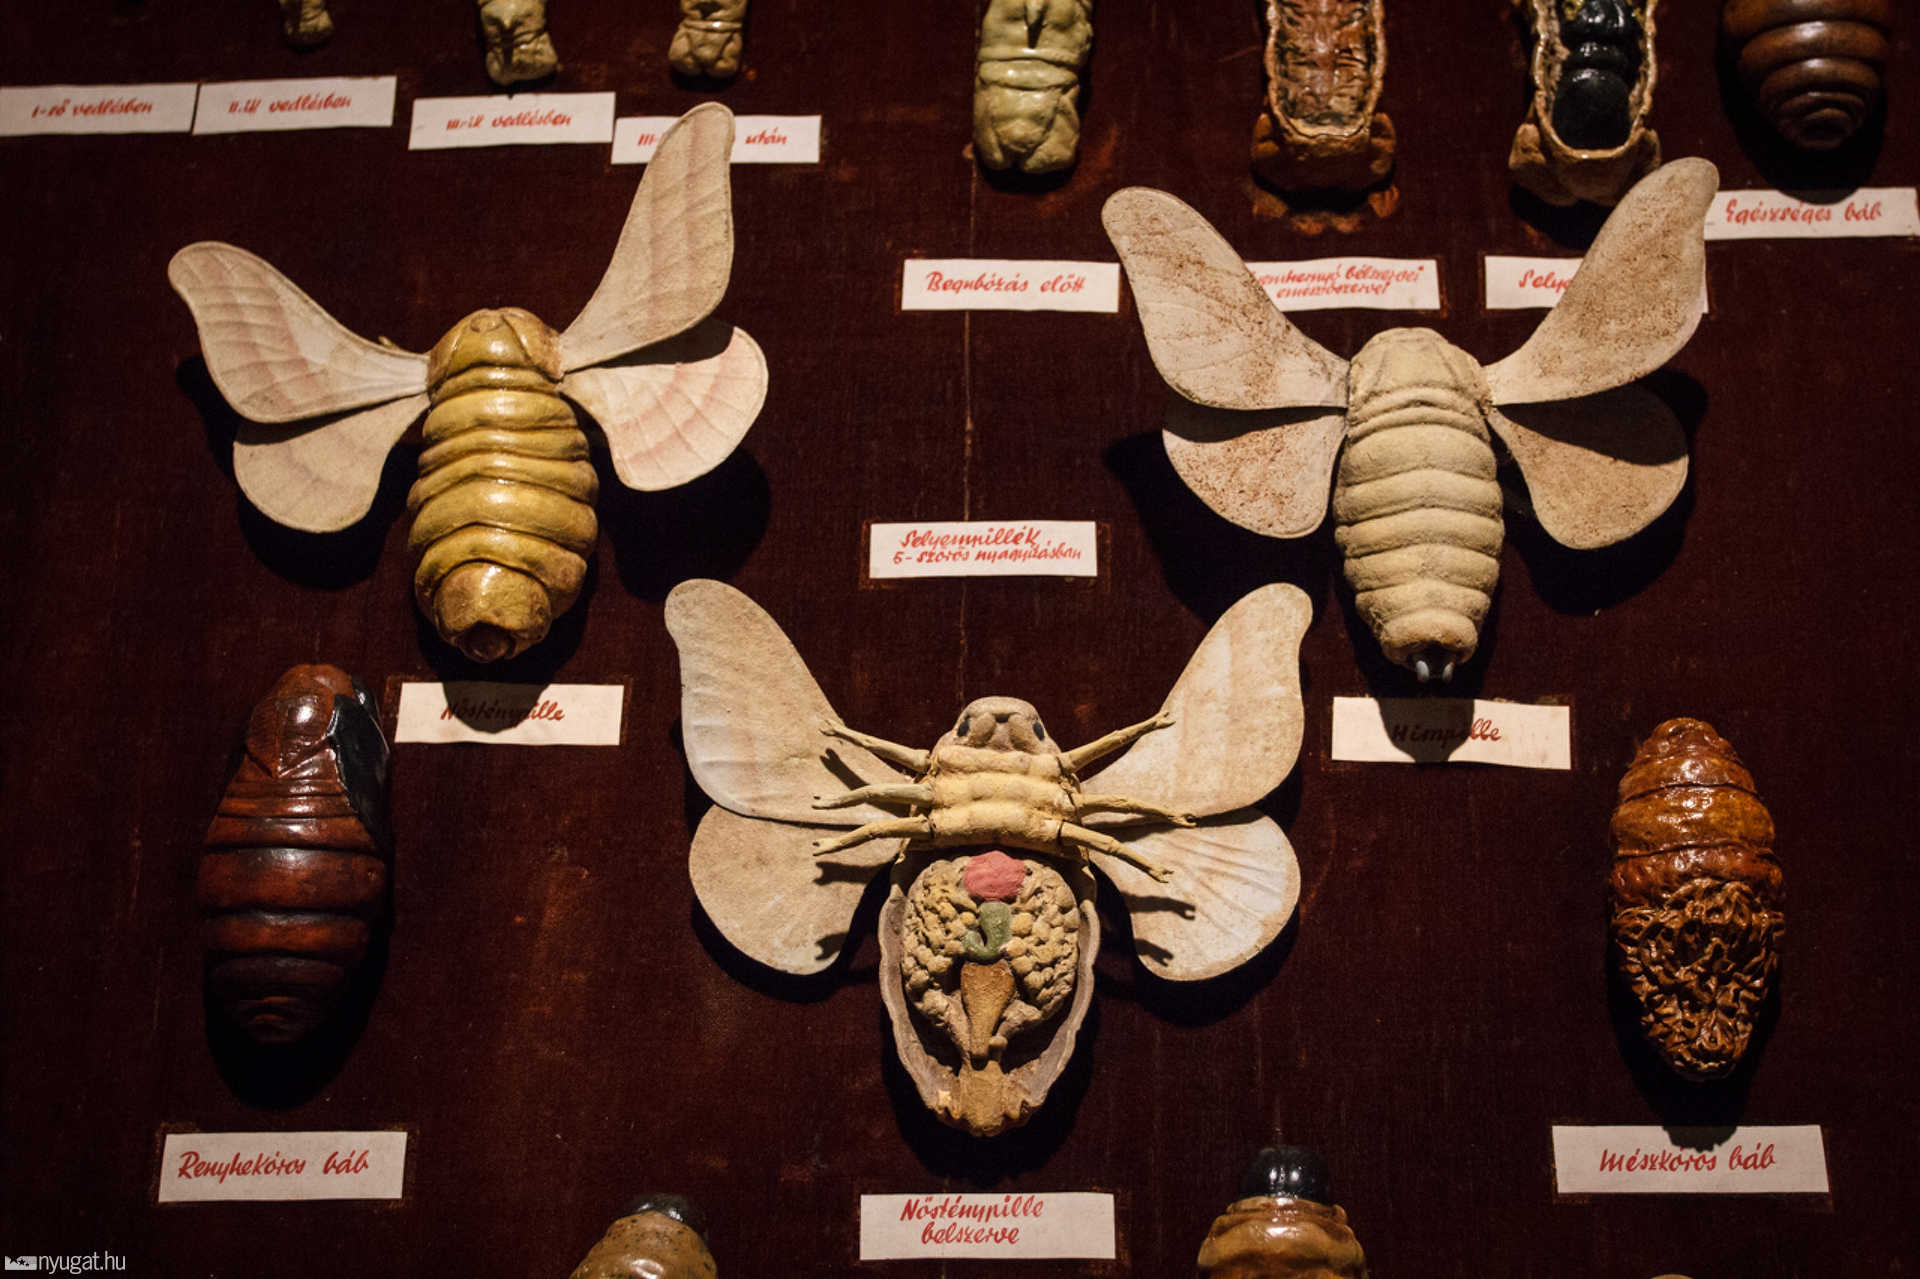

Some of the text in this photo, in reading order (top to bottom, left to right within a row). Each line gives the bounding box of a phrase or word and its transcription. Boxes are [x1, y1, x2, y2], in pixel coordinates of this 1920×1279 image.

[746, 128, 787, 144] után
[1726, 199, 1882, 224] Egészséges báb
[926, 271, 1086, 293] Begubózás előtt
[901, 525, 1041, 550] Selyempillék
[178, 1150, 368, 1184] Renyhekóros báb
[1728, 1144, 1774, 1170] báb
[901, 1194, 1043, 1225] Nősténypille
[922, 1220, 1019, 1244] belszerve
